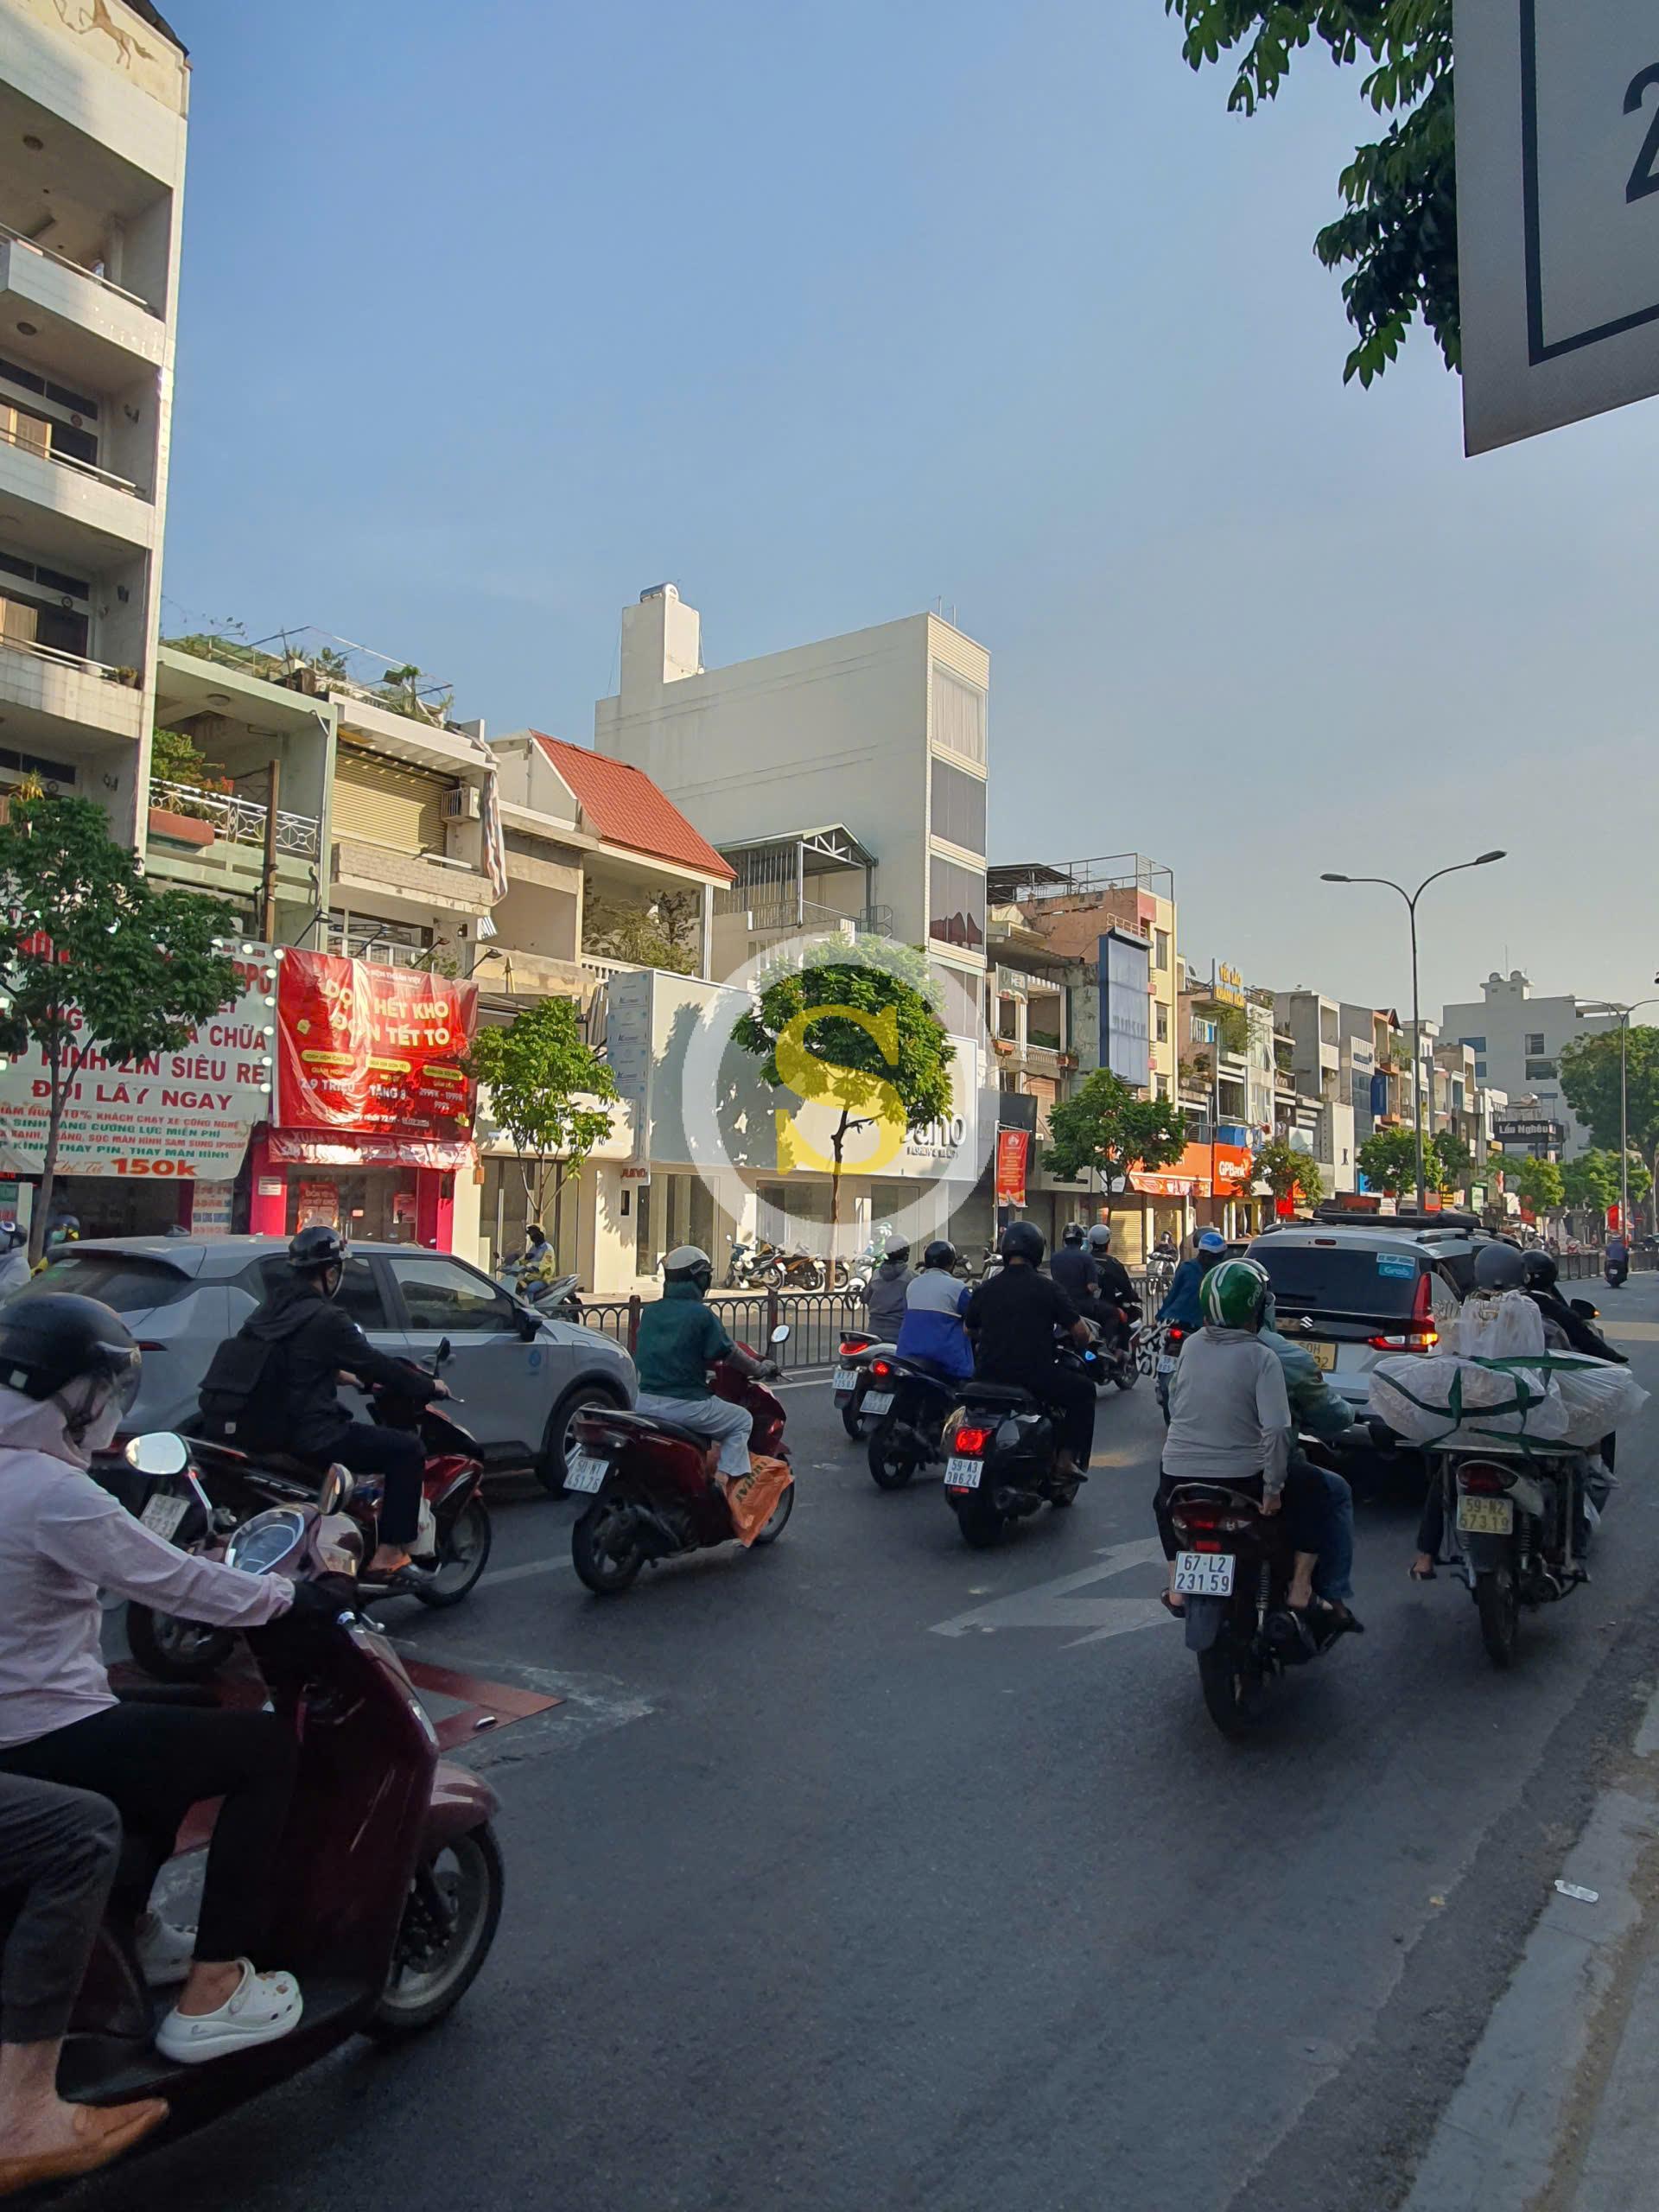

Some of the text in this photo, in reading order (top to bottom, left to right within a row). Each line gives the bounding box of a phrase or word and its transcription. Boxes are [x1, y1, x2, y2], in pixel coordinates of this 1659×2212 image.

[412, 999, 448, 1020] KHO
[209, 1023, 267, 1052] CHỮA
[423, 1027, 449, 1046] TO
[170, 1052, 227, 1082] SIÊU
[161, 1089, 233, 1111] NGAY
[13, 1117, 48, 1128] SINH
[59, 1143, 92, 1154] THAY
[130, 1147, 162, 1158] THAY
[110, 1156, 199, 1176] 150k
[1218, 1160, 1246, 1178] GPBank
[1184, 1554, 1227, 1573] 67-L2
[1176, 1573, 1230, 1593] 231.59
